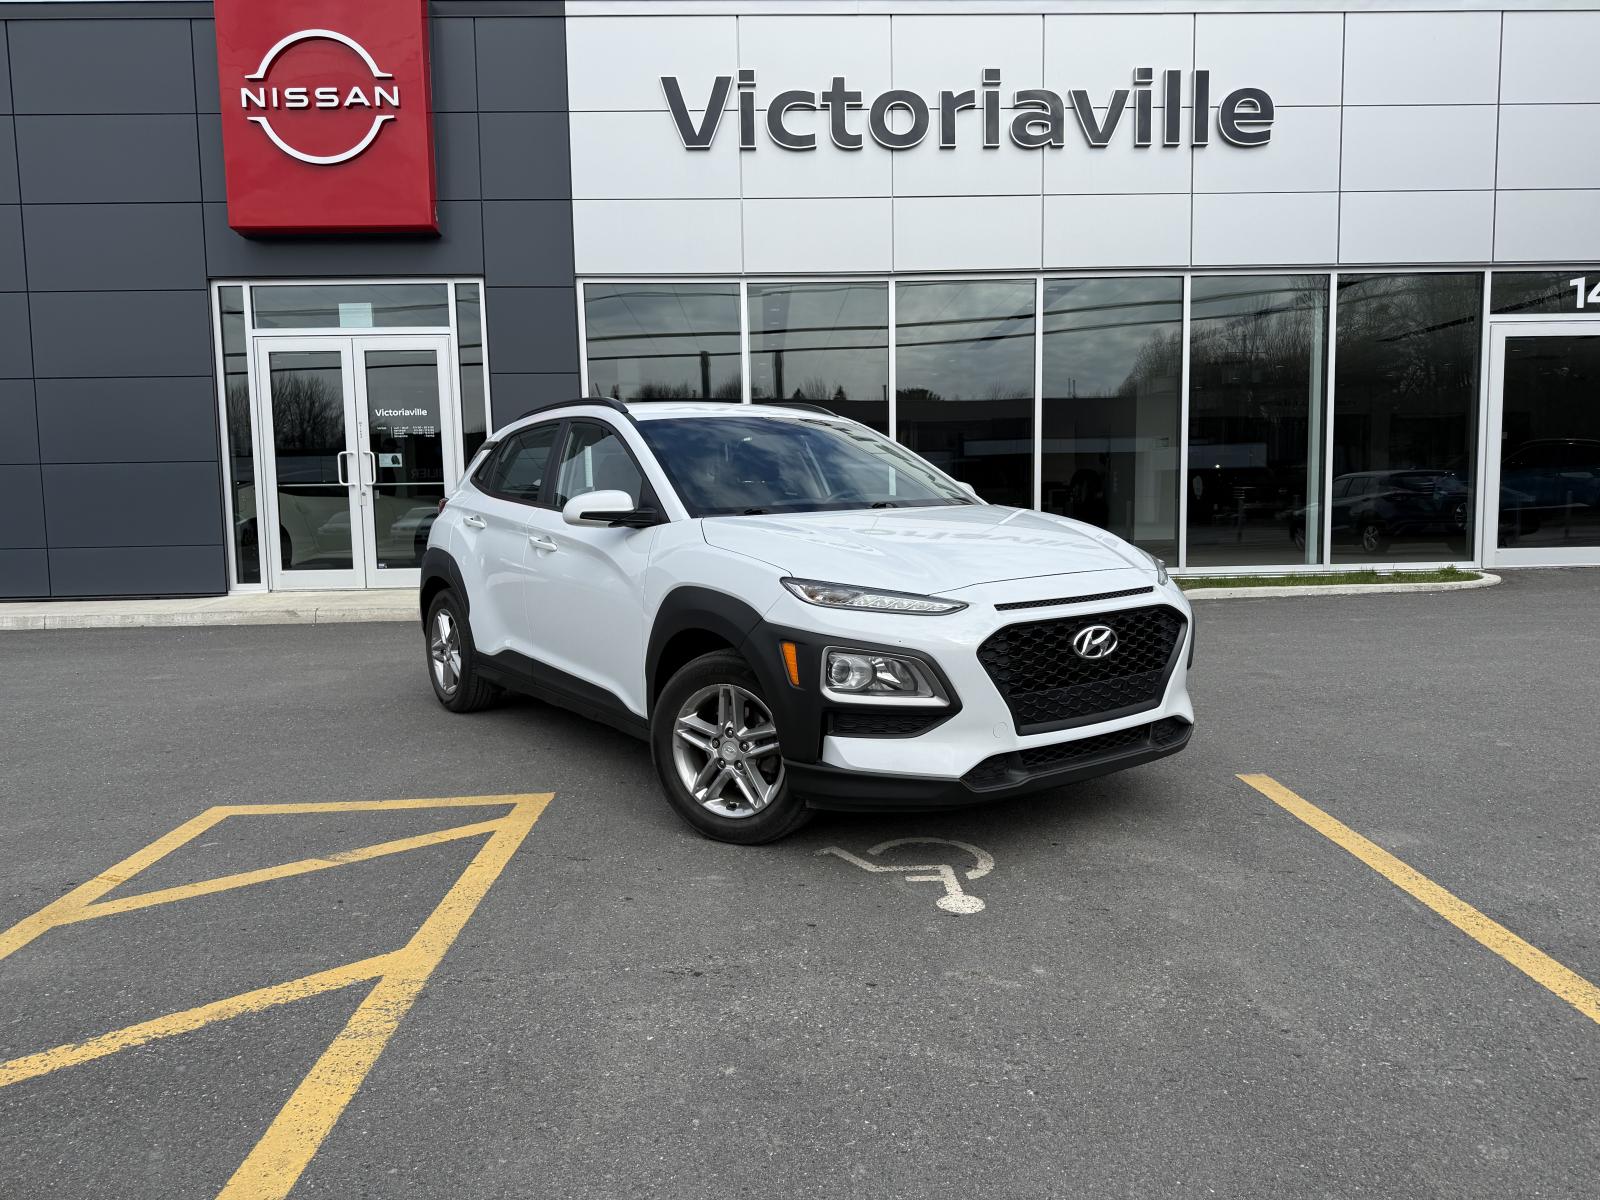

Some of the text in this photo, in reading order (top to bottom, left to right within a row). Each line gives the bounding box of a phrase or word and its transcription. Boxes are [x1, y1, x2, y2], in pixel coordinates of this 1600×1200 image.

[240, 86, 400, 109] NISSAN
[659, 68, 1275, 152] Victoriaville
[375, 407, 428, 417] Victoriaville
